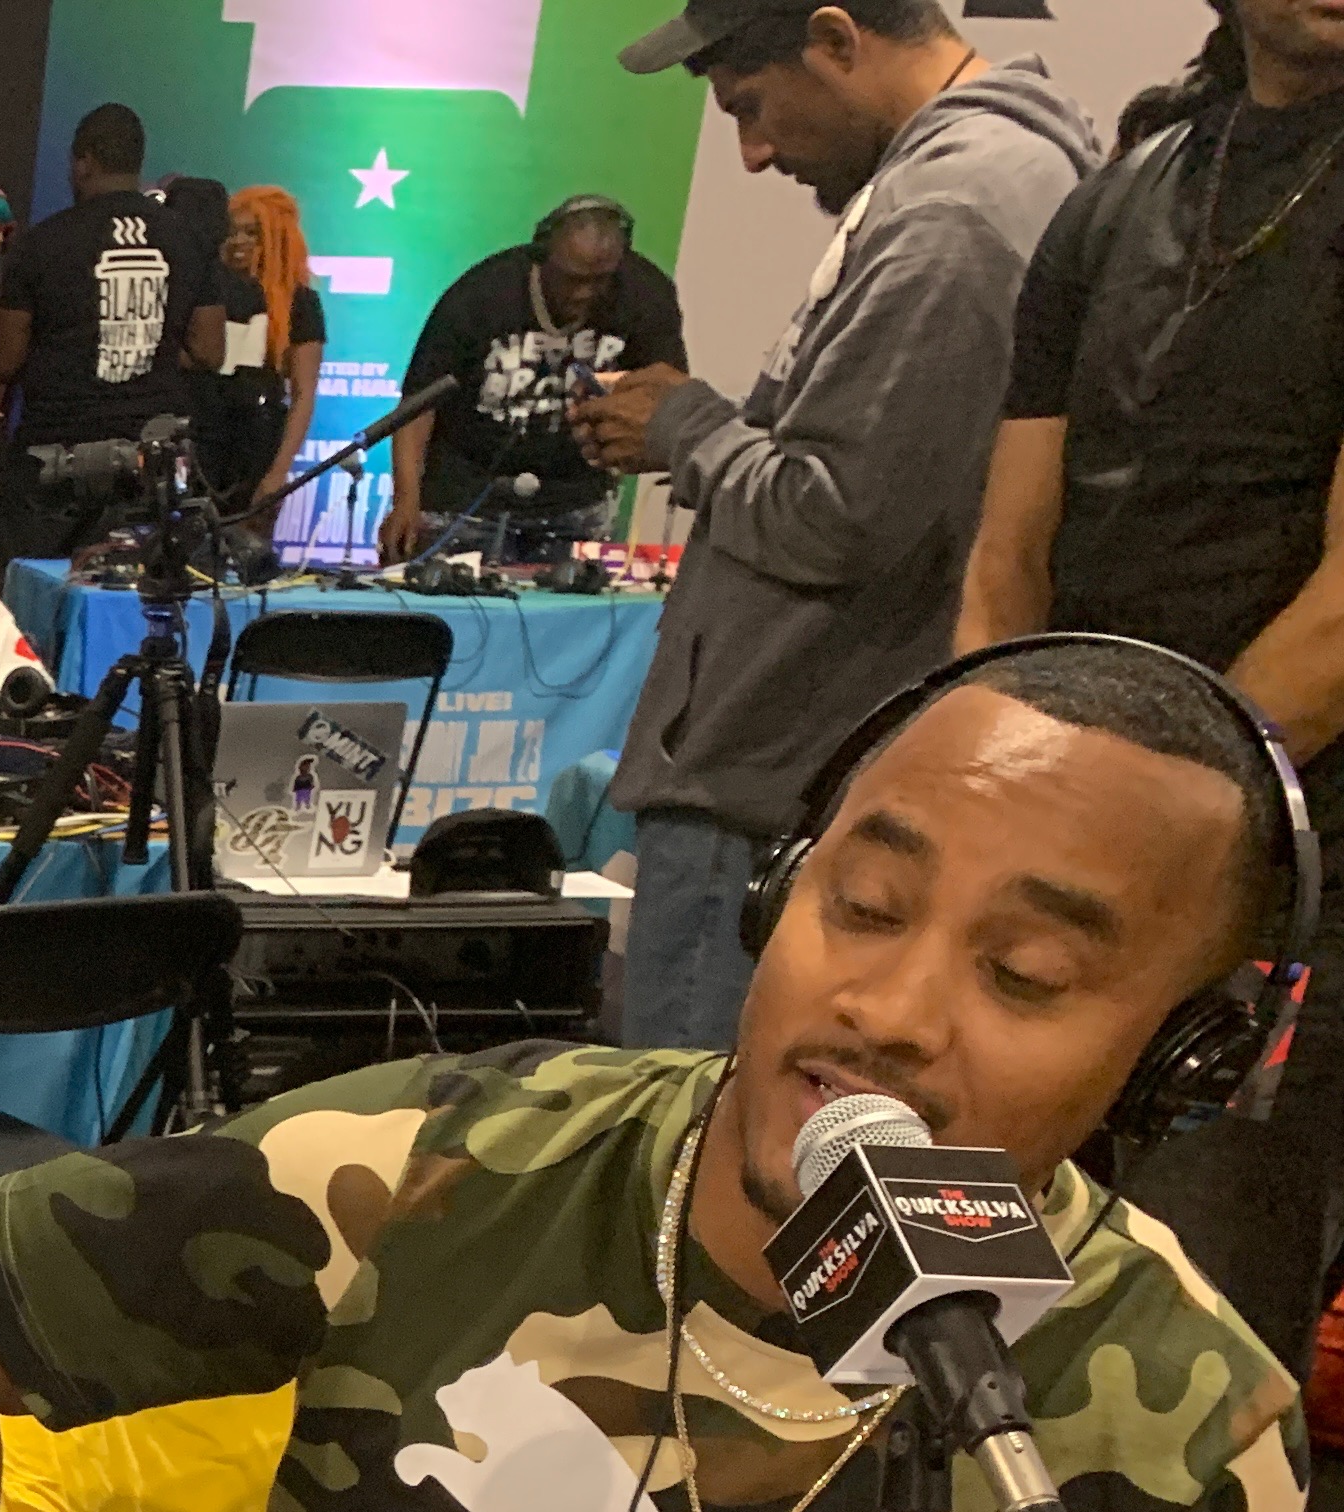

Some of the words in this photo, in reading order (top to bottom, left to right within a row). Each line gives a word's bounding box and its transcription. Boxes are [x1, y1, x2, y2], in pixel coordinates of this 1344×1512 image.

[99, 277, 169, 321] BLACK
[937, 1188, 966, 1201] THE
[894, 1196, 1028, 1220] QUICKSILVA
[943, 1215, 992, 1228] SHOW
[792, 1210, 880, 1311] QUICKSILVA
